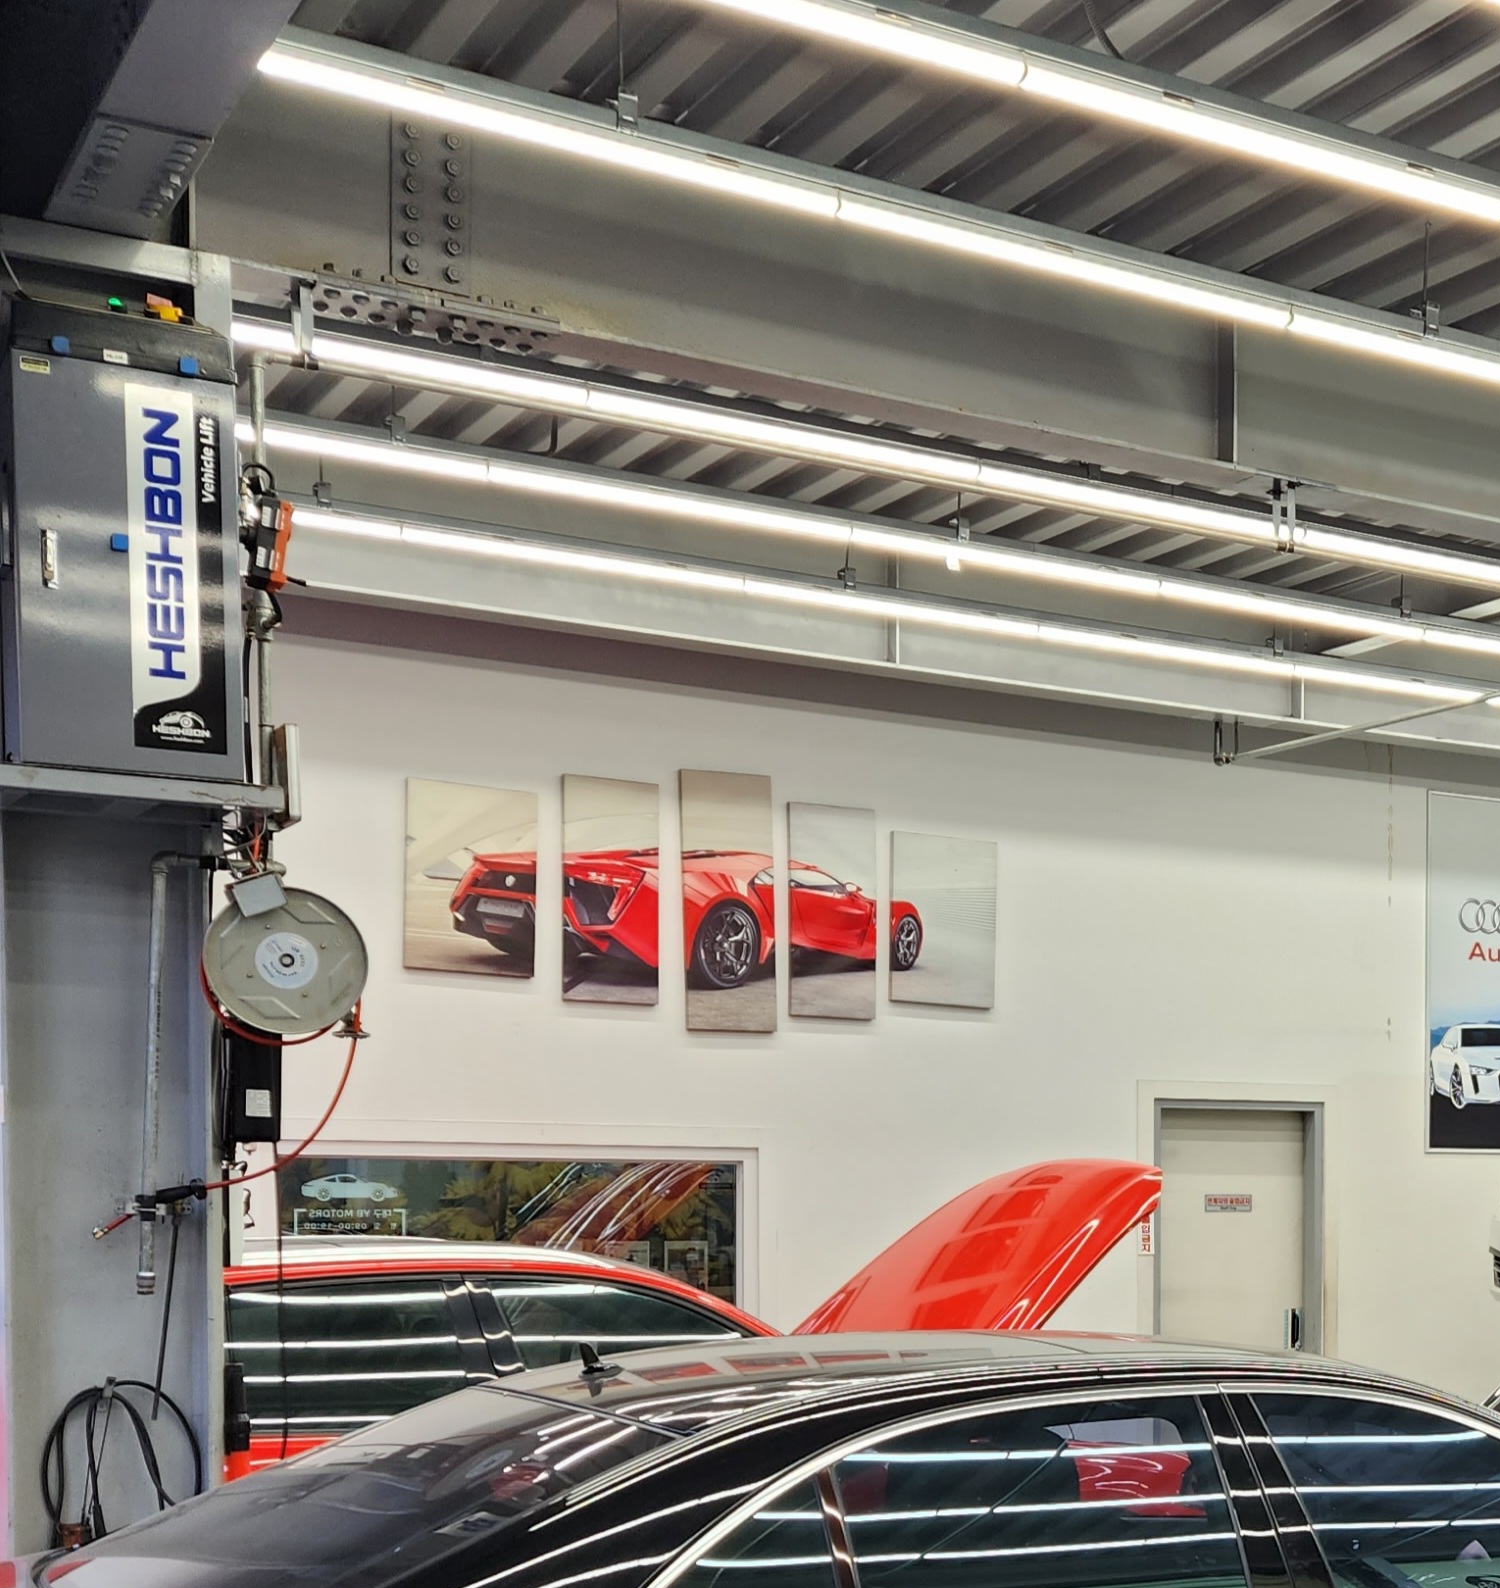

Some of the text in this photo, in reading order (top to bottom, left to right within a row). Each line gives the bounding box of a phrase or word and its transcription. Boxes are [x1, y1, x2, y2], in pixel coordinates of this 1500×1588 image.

[141, 407, 186, 680] HESHBON
[200, 416, 216, 503] Vehicle Lift
